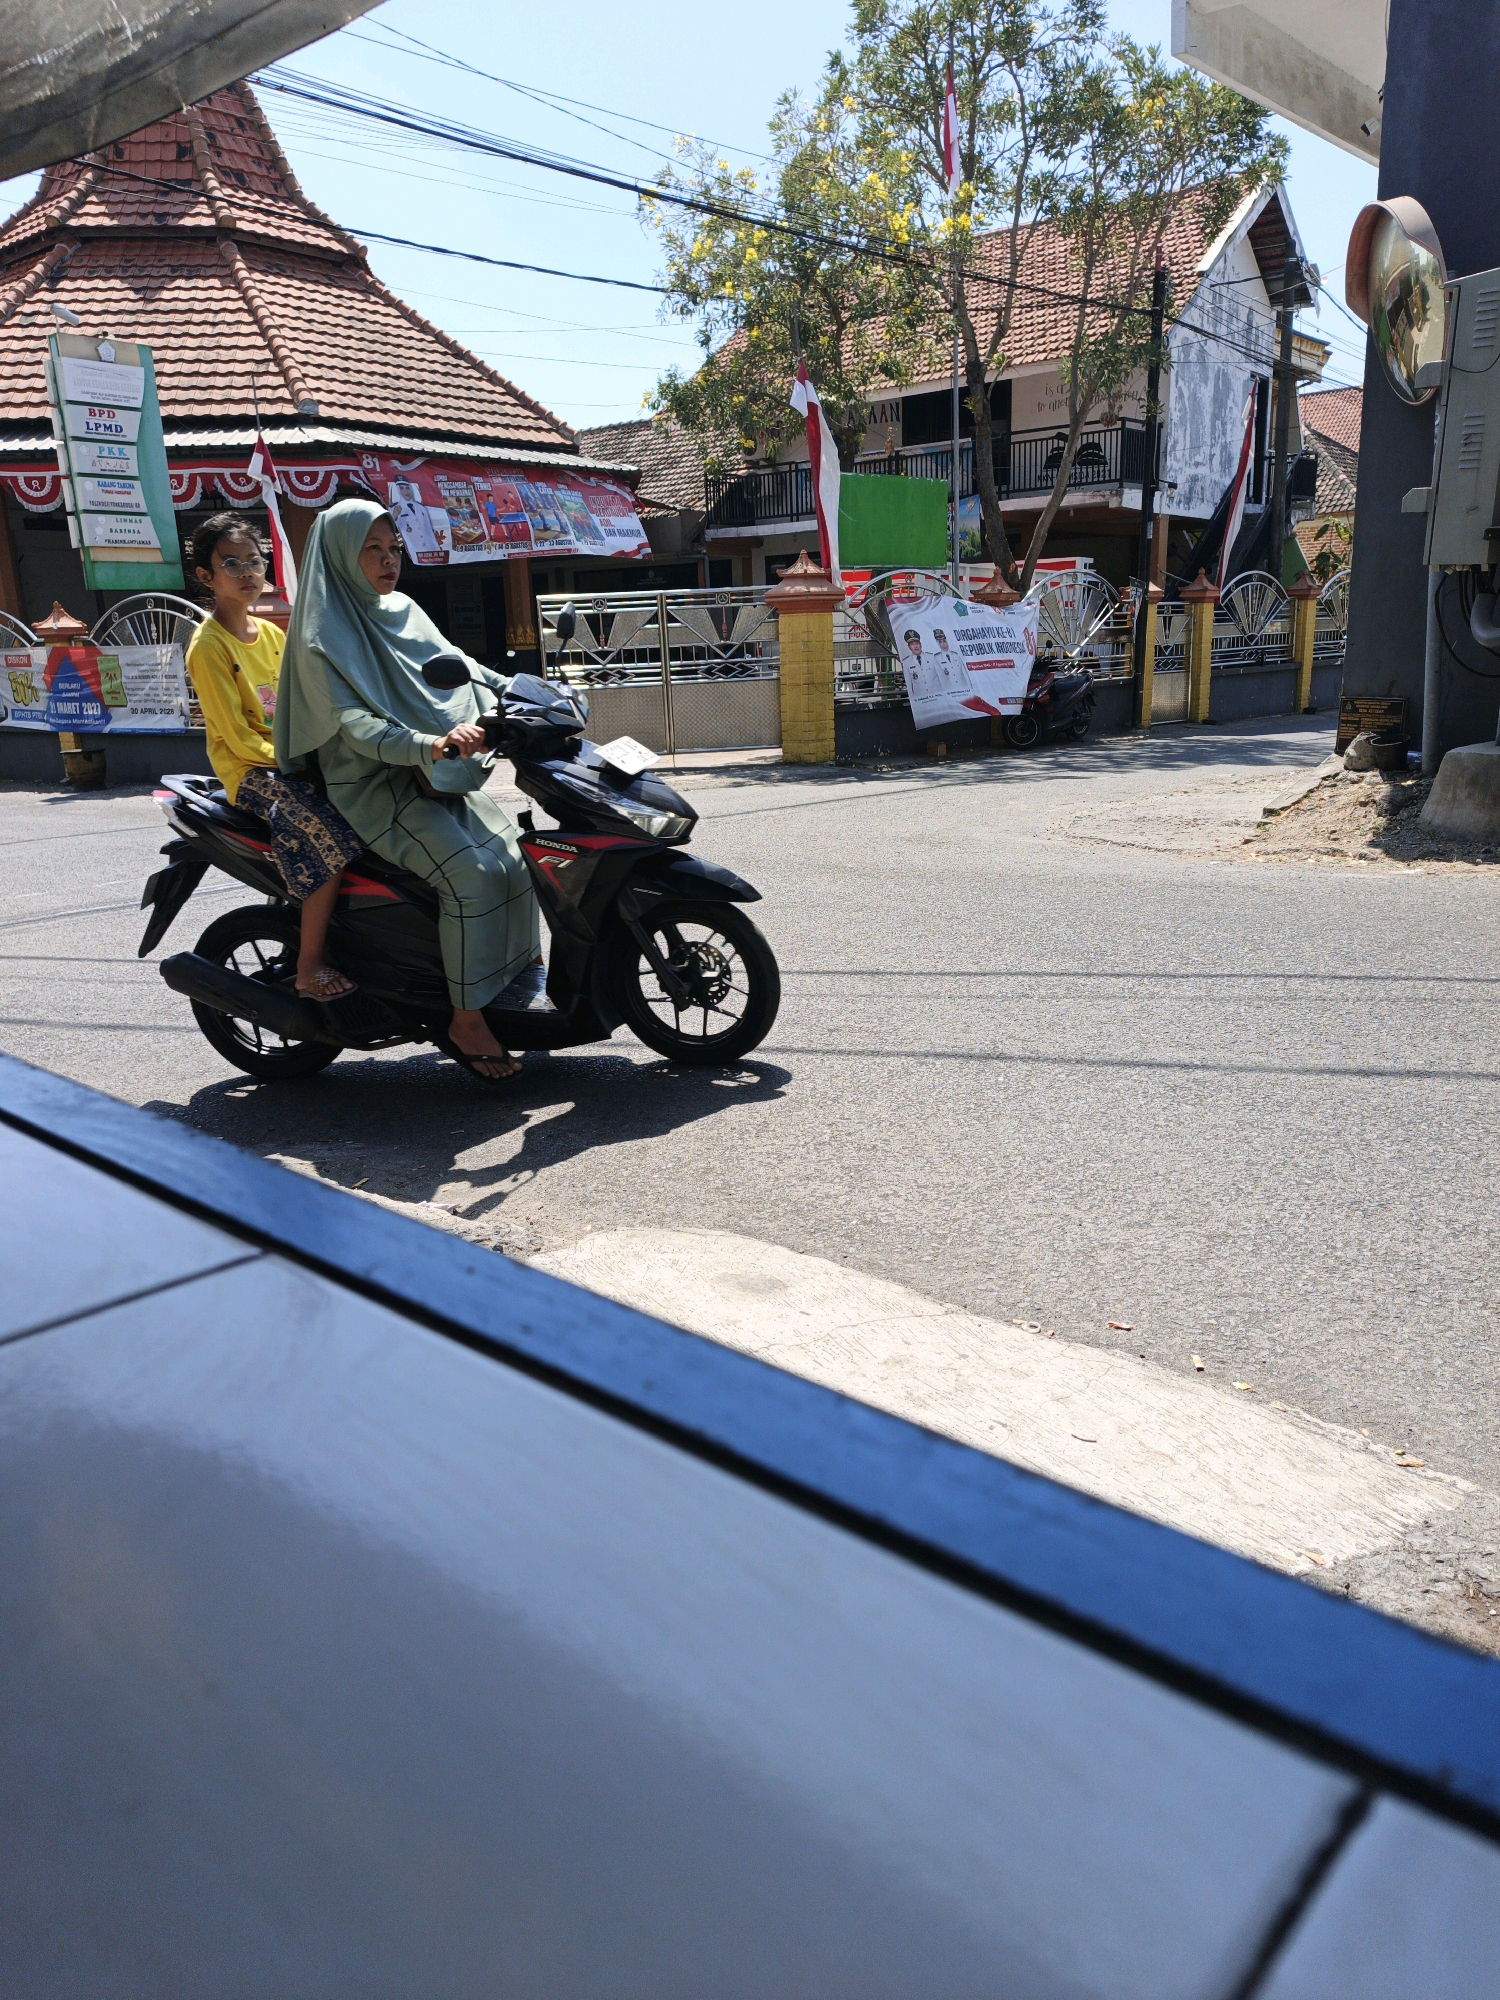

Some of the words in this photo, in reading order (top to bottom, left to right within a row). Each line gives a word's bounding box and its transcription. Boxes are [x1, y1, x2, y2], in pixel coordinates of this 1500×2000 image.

[1045, 383, 1053, 398] is
[88, 408, 116, 419] BPD
[85, 421, 123, 434] LPMD
[98, 446, 127, 456] PKK
[362, 454, 380, 472] 81
[604, 528, 617, 537] DAN
[953, 626, 996, 641] DIRGAHAYU
[996, 626, 1016, 639] KE-81
[959, 642, 996, 656] REPUBLIK
[995, 642, 1026, 654] INDONESIA
[8, 671, 40, 706] 50%
[57, 702, 80, 714] MARET
[535, 838, 578, 853] HONDA
